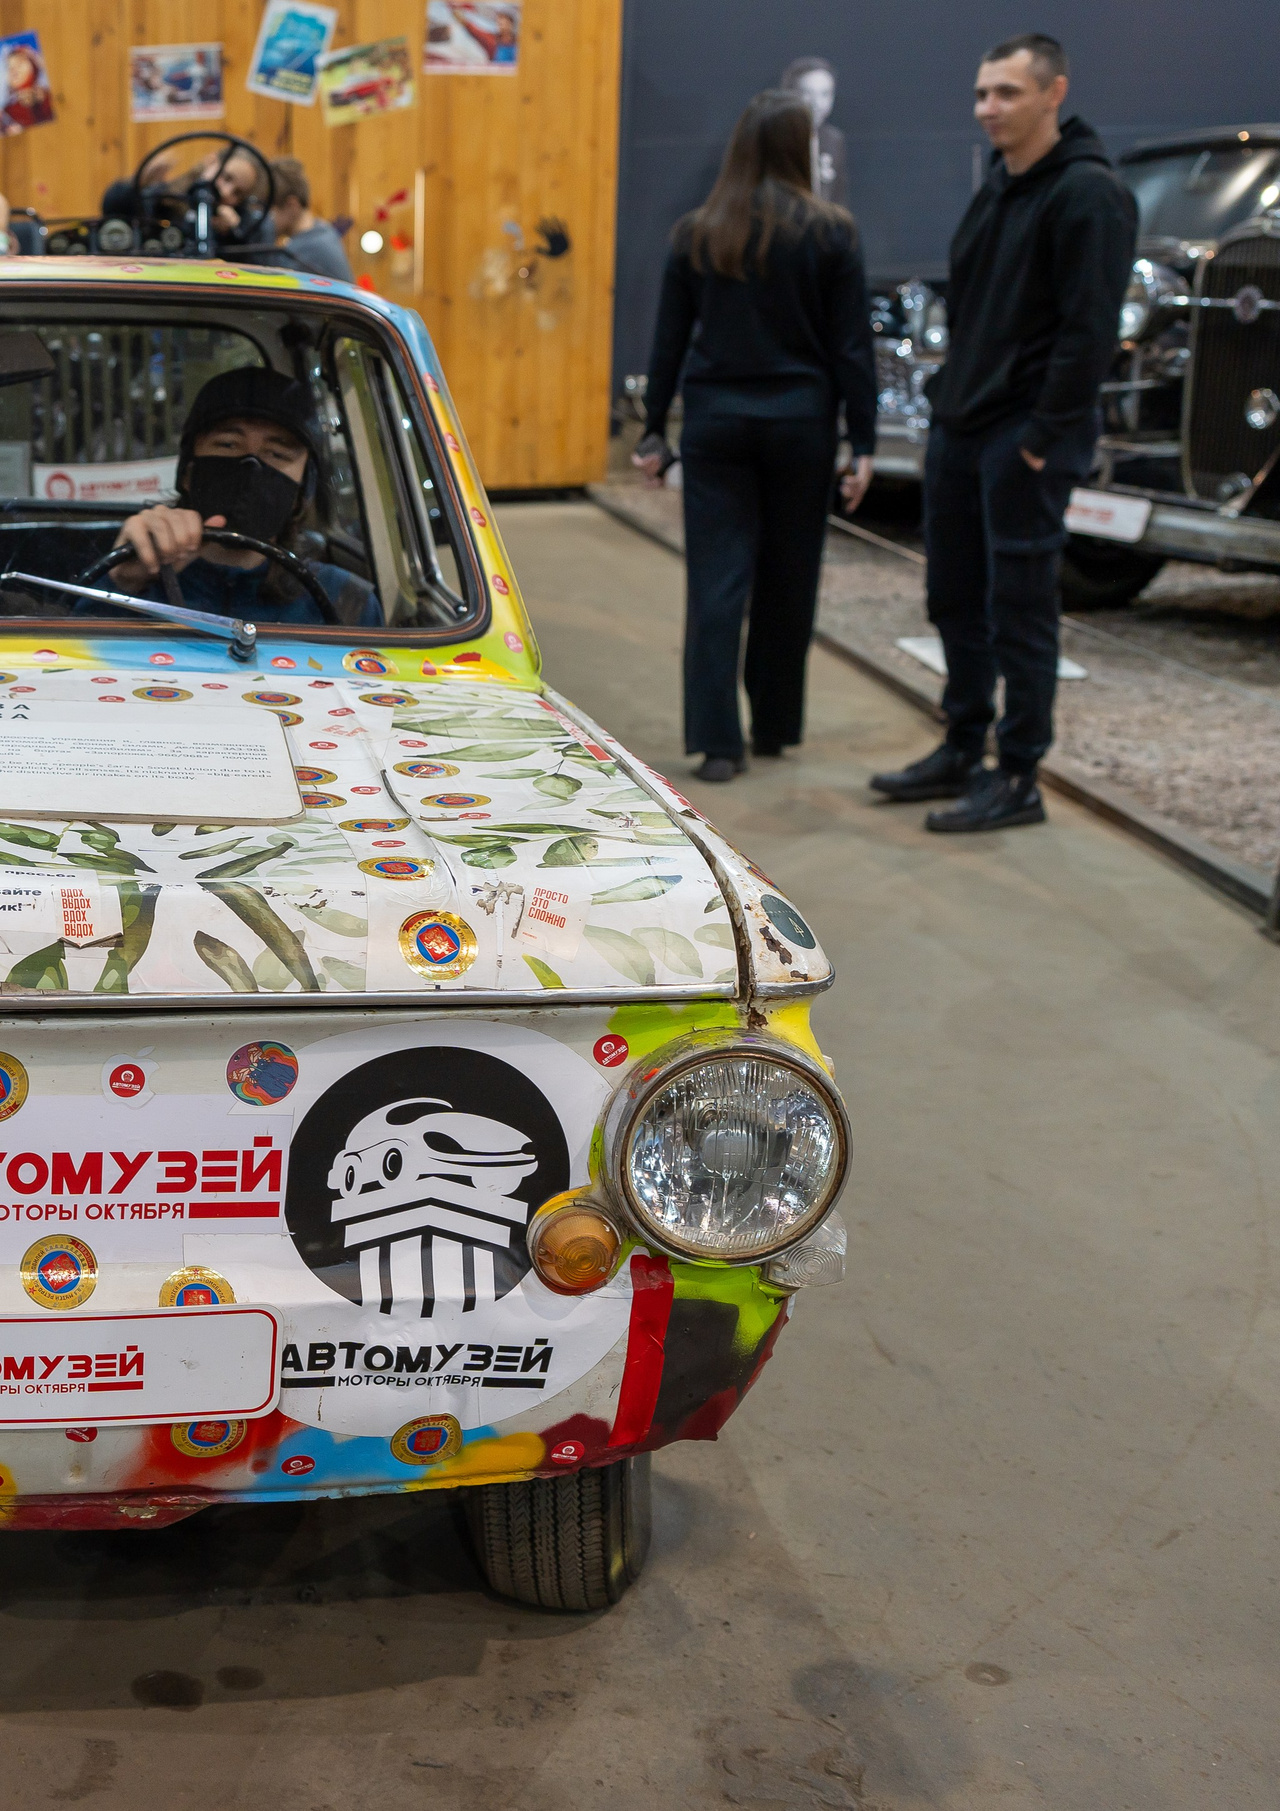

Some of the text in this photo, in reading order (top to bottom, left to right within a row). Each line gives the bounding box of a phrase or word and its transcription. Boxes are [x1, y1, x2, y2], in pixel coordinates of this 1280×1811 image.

[60, 888, 84, 898] ВДОХ
[534, 887, 569, 904] ПРОСТО
[531, 896, 549, 910] ЭТО
[63, 910, 87, 923] ВДОХ
[528, 906, 567, 928] СЛОЖНО
[85, 1202, 185, 1220] ОКТЯБРЯ
[281, 1338, 554, 1373] АВТОМУЗЕЙ
[337, 1374, 480, 1388] МОТОРЫ ОКТЯБРЯ
[24, 1383, 86, 1394] ОКТЯБРЯ
